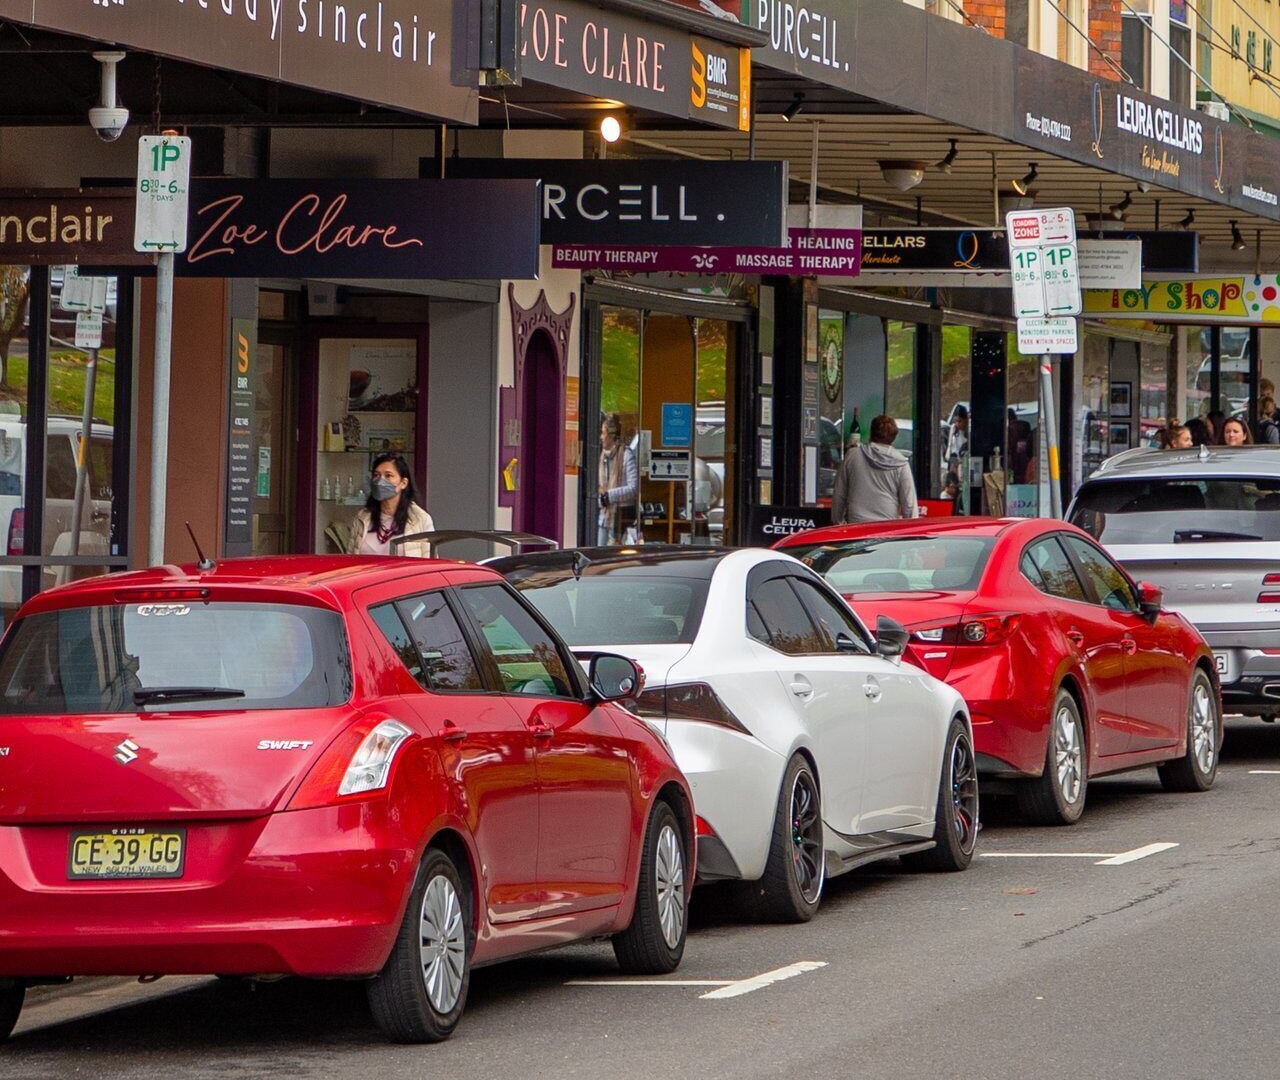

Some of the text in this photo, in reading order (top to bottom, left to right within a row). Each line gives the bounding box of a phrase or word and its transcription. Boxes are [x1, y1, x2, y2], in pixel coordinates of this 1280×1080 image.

[581, 21, 666, 93] CLARE
[706, 53, 727, 86] BMR
[1116, 93, 1204, 156] LEURA CELLARS
[151, 144, 181, 172] 1P
[187, 193, 423, 264] Zoe Clare
[1014, 227, 1039, 237] ZONE
[797, 237, 855, 250] HEALING
[861, 236, 926, 248] ELLARS
[556, 249, 659, 264] BEAUTY THERAPY
[735, 254, 856, 270] MASSAGE THERAPY
[1015, 252, 1037, 269] 1P
[1046, 247, 1072, 266] 1P
[762, 524, 816, 535] CELLA
[772, 516, 816, 528] LEURA
[256, 739, 315, 752] SWIFT
